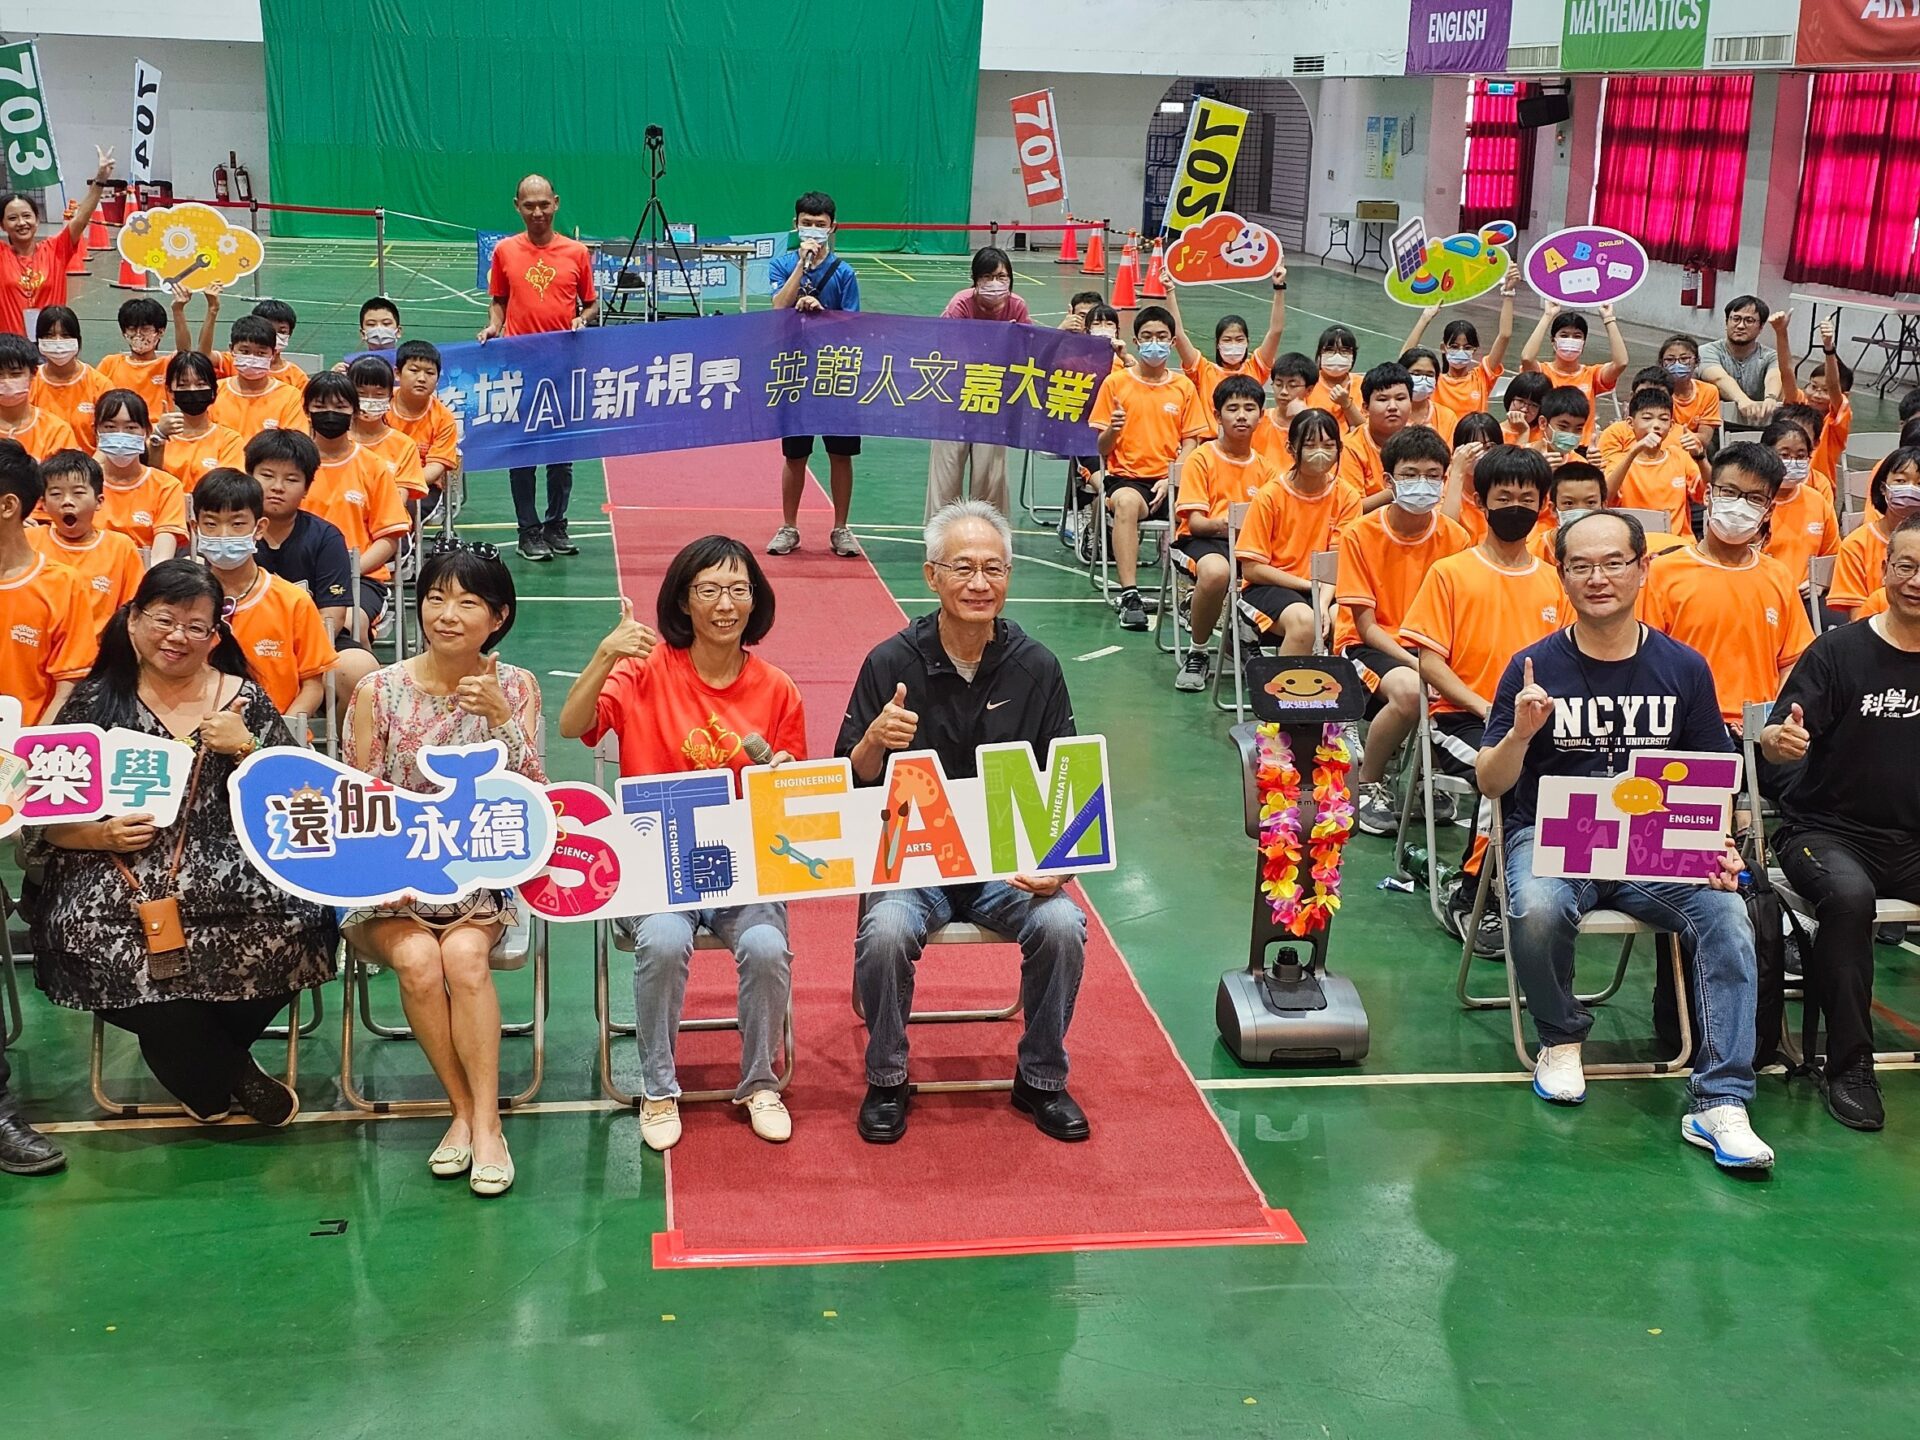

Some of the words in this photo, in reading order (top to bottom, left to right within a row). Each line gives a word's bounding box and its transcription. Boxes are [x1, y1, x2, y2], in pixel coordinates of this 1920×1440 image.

[1427, 8, 1488, 44] ENGLISH
[1569, 0, 1702, 35] MATHEMATICS
[0, 52, 53, 176] 703
[1014, 99, 1061, 196] 701
[1598, 238, 1625, 248] ENGLISH
[766, 344, 1097, 422] 共譜人文嘉大業
[1552, 695, 1677, 738] NCYU
[1626, 736, 1672, 746] UNIVERSITY
[774, 774, 843, 789] ENGINEERING
[1050, 755, 1070, 837] MATHEMATICS
[1669, 814, 1714, 825] ENGLISH
[552, 845, 596, 863] CIENCE
[669, 817, 682, 895] TECHNOLOGY
[905, 842, 932, 853] ARTS
